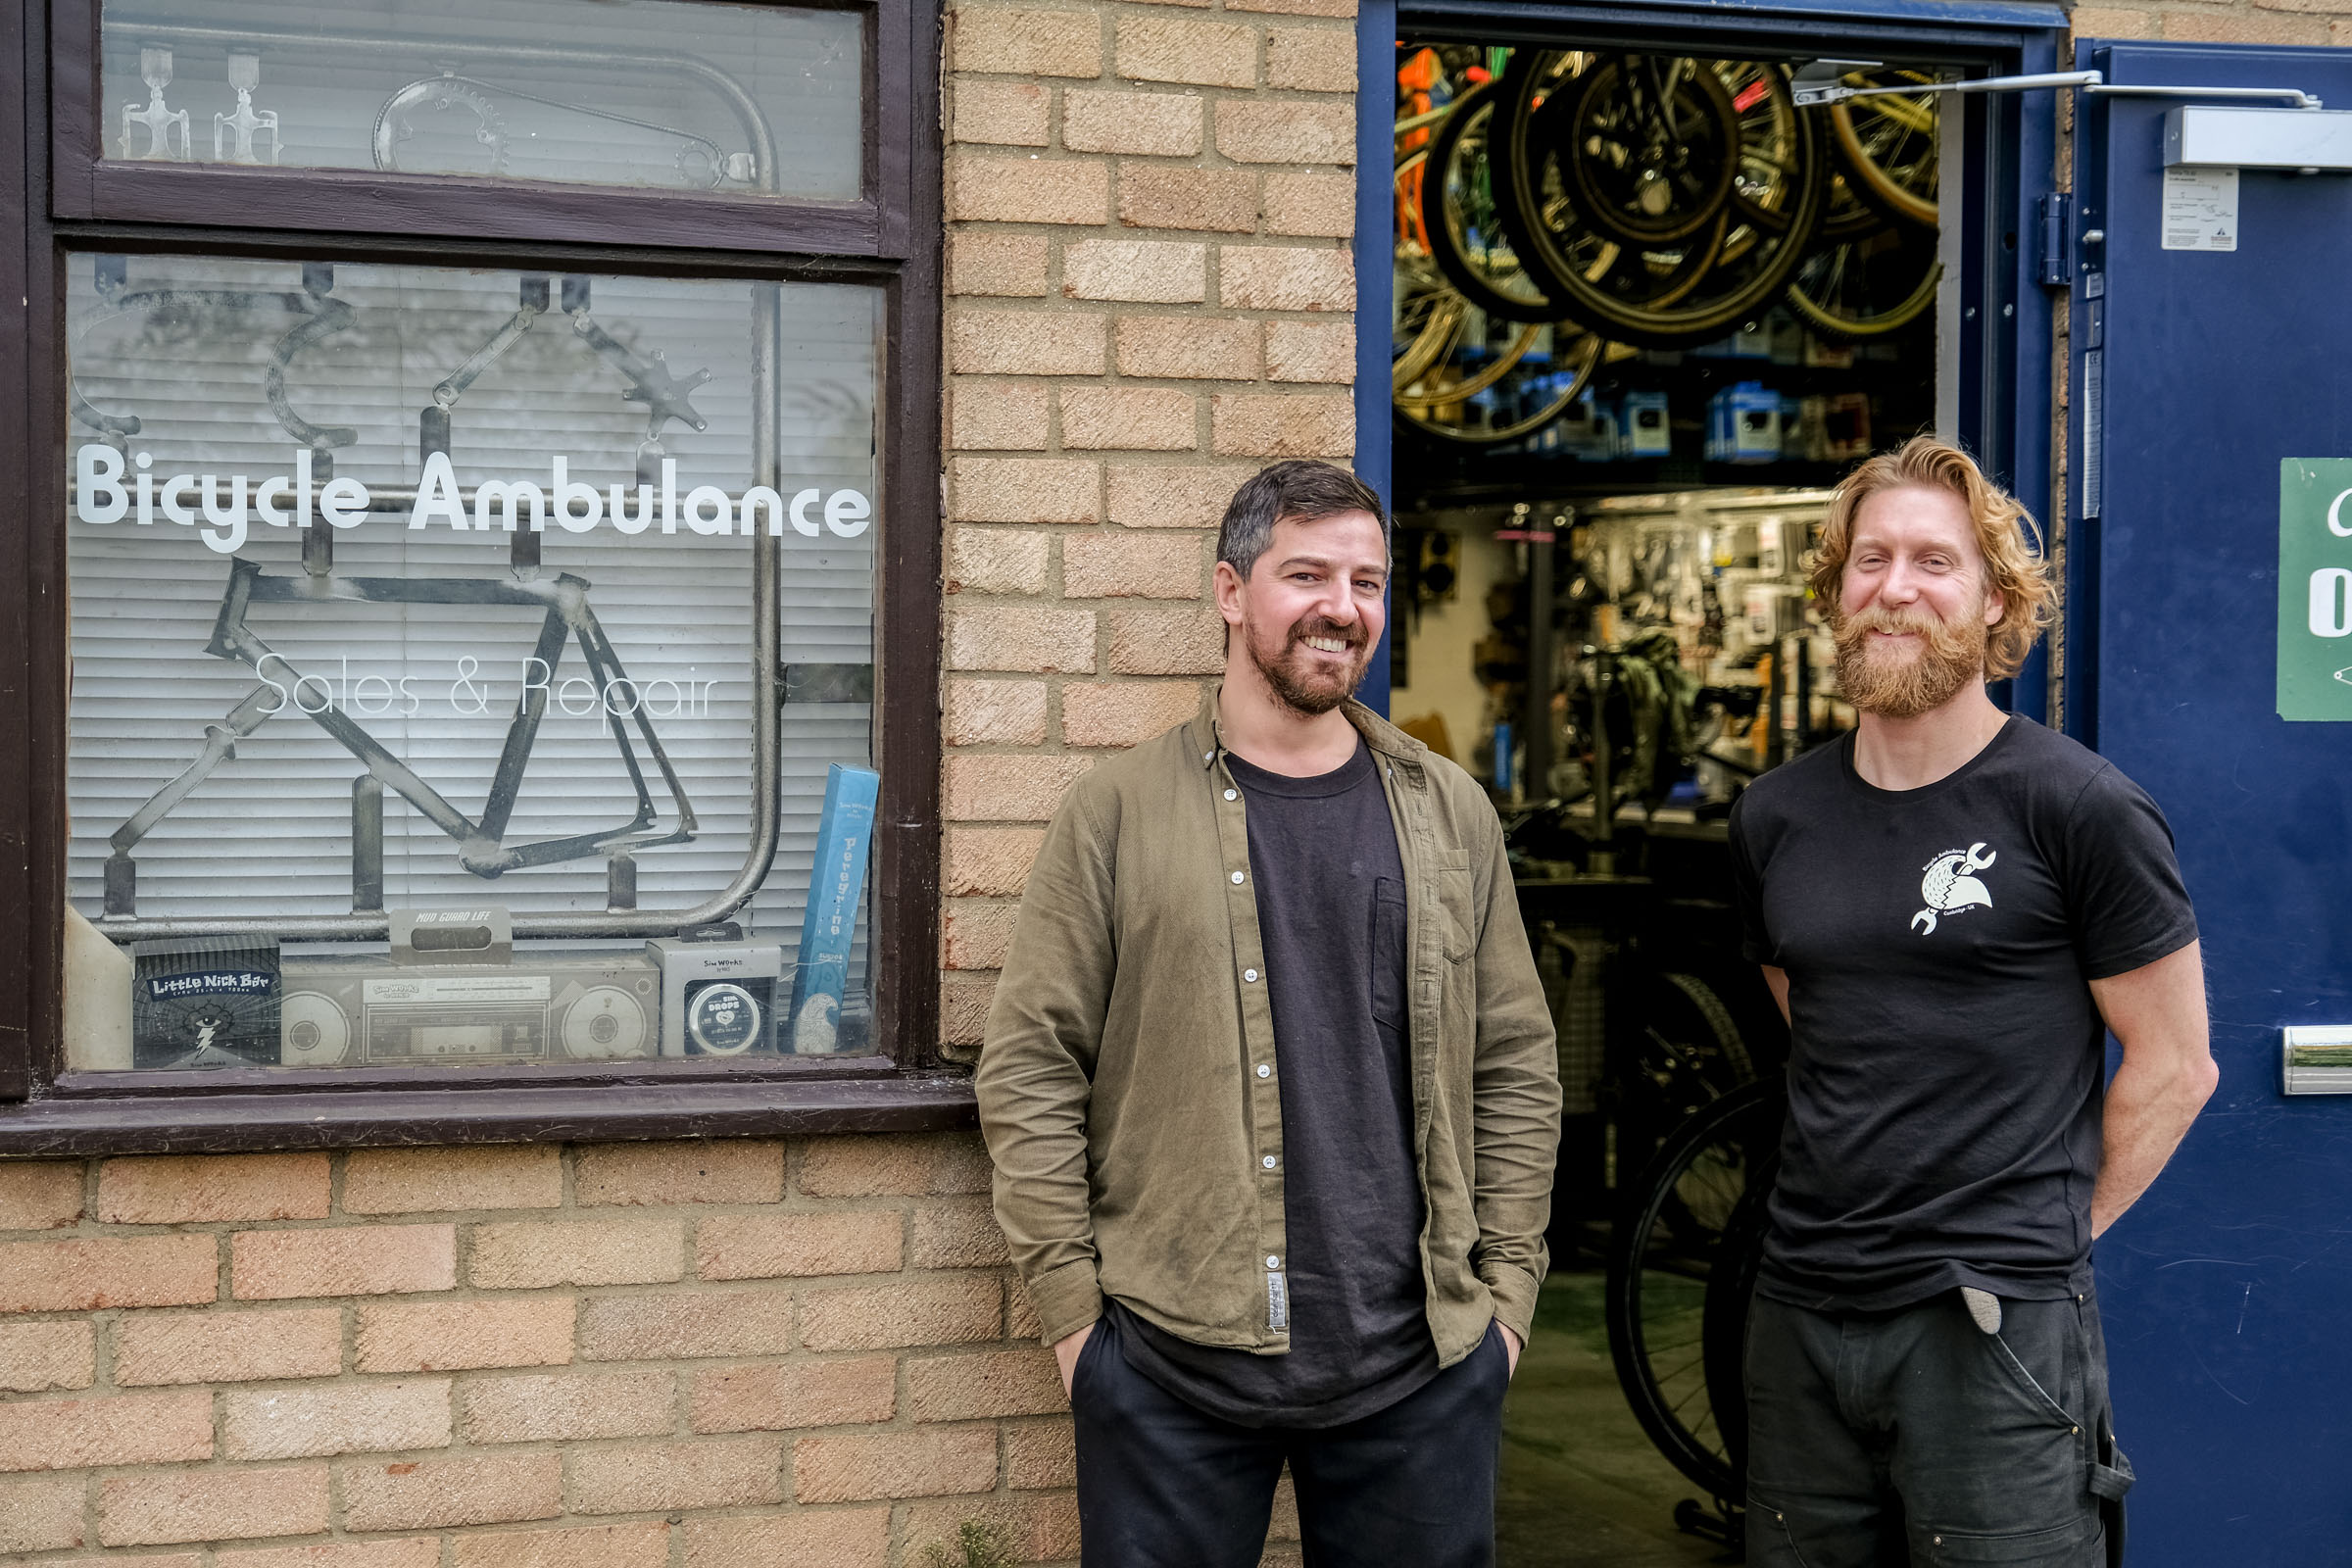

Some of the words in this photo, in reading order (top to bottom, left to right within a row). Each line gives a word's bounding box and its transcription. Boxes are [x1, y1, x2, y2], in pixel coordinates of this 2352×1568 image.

[76, 444, 370, 554] Bicycle
[408, 451, 871, 538] Ambulance
[256, 653, 419, 714] Sales
[450, 655, 489, 714] &
[522, 657, 718, 736] Repair
[416, 912, 437, 922] MUD
[471, 910, 492, 921] LIFE
[153, 977, 202, 995] Little
[204, 975, 237, 987] Nick
[240, 973, 269, 988] Bar
[709, 1001, 740, 1011] DROPS
